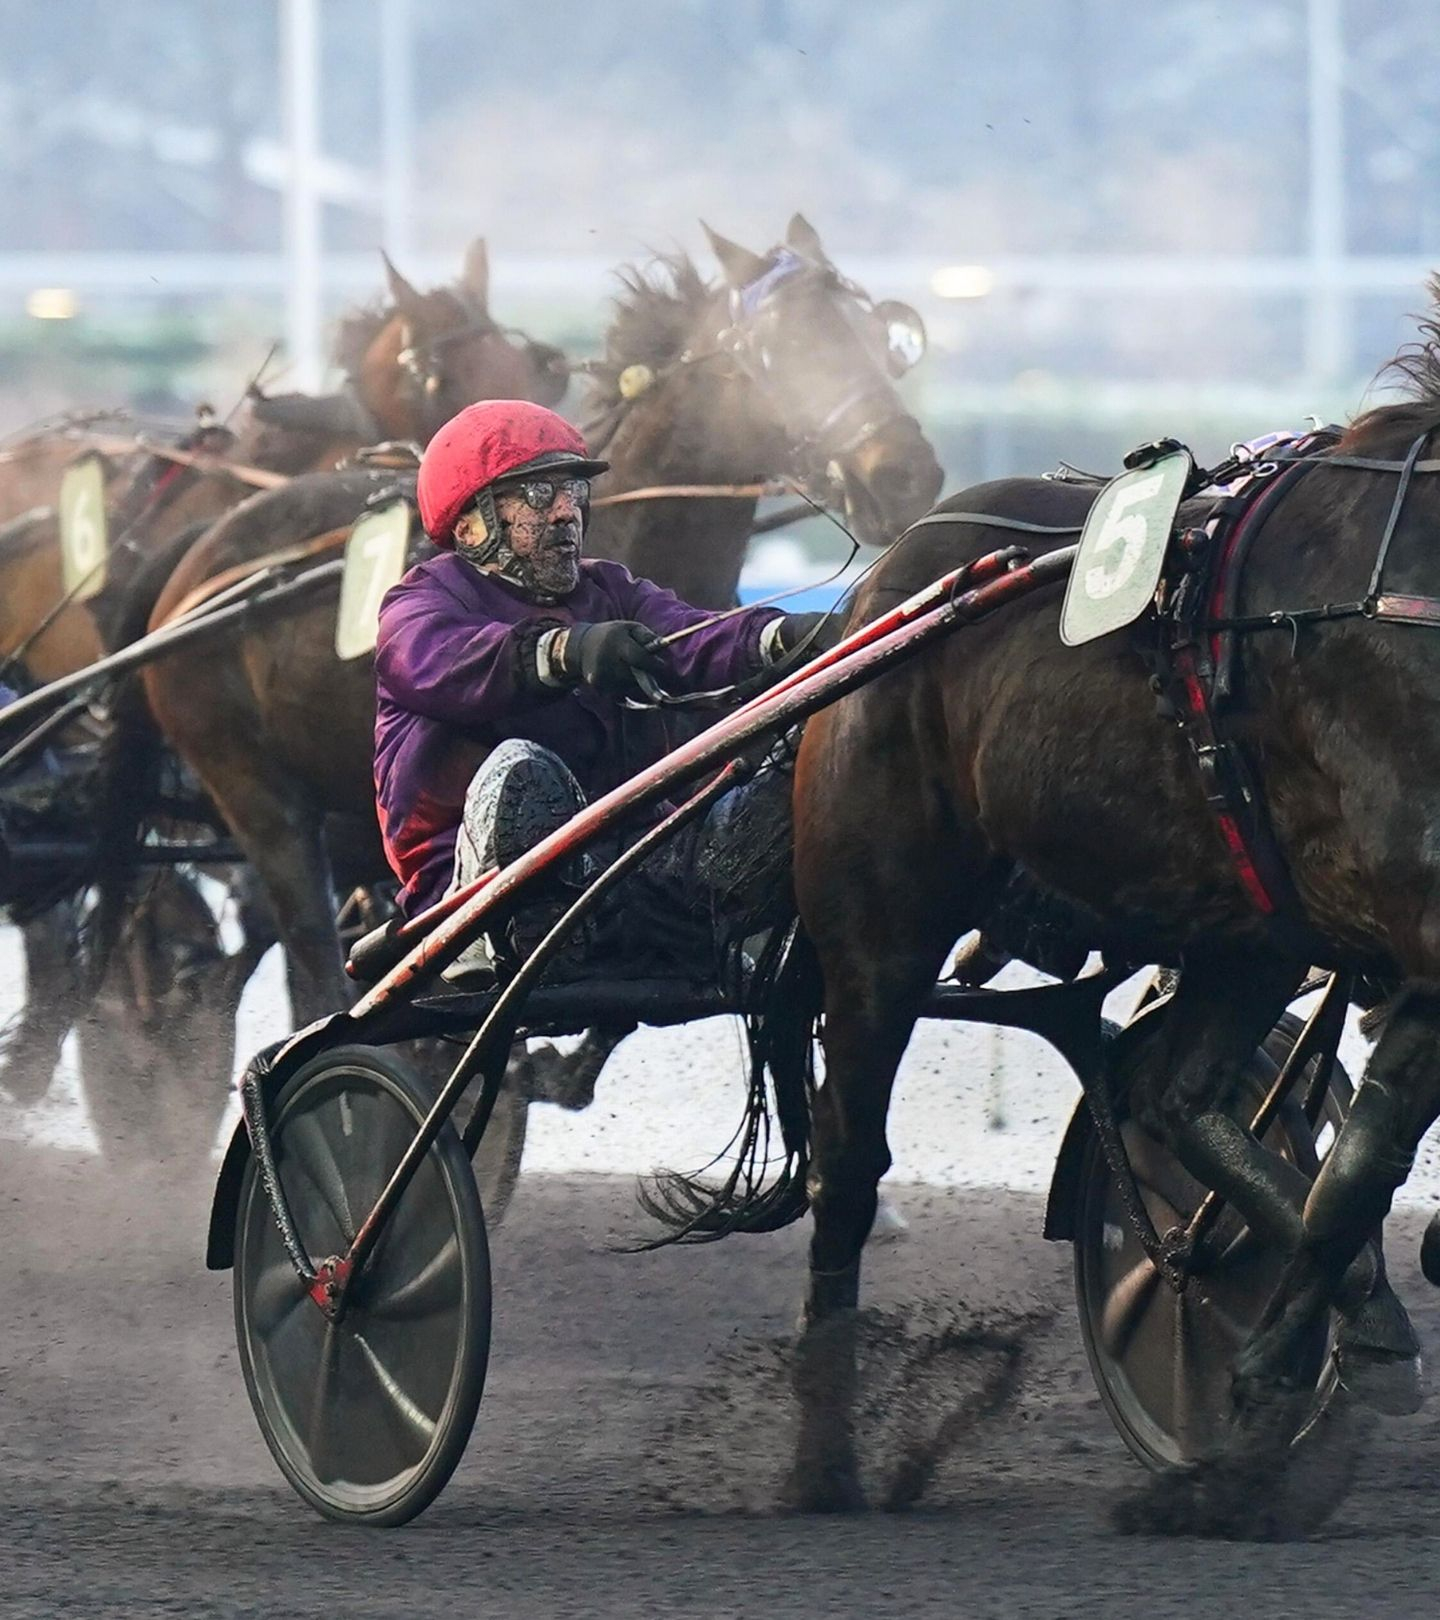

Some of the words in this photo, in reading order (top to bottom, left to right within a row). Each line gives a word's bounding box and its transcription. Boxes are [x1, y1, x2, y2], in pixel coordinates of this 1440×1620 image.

[72, 490, 96, 575] 6
[362, 531, 392, 627] 7
[1085, 473, 1164, 600] 5
